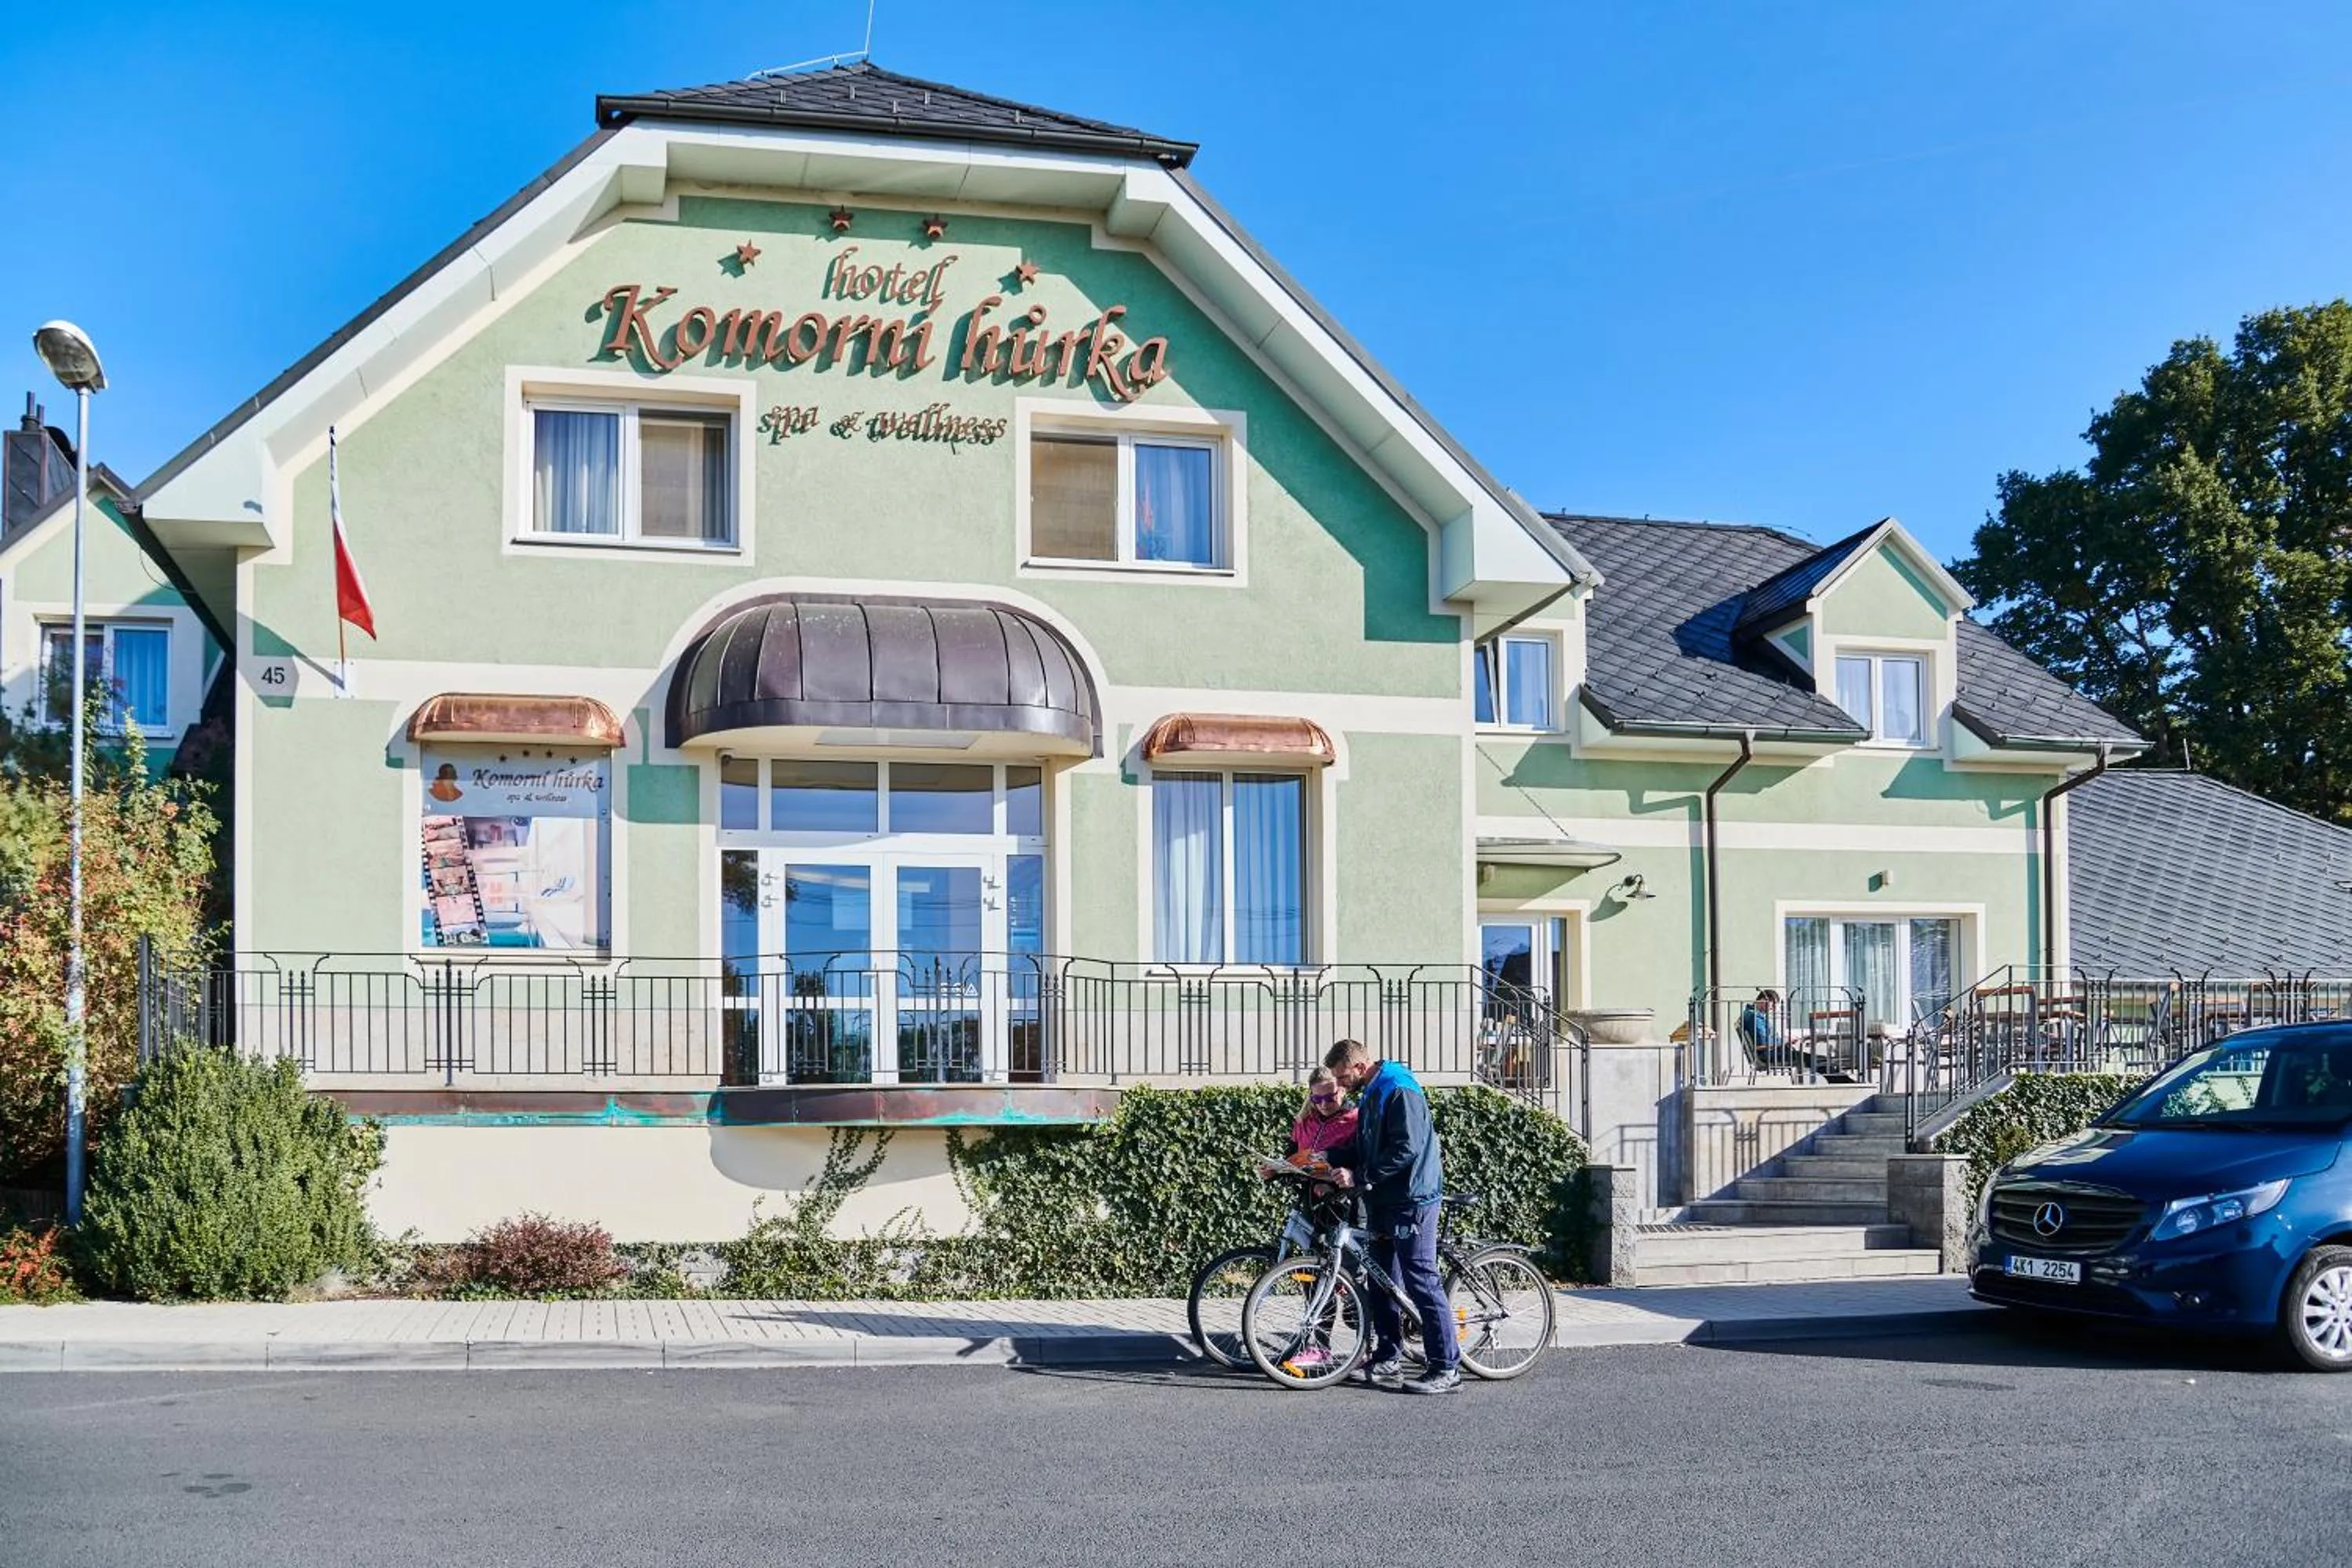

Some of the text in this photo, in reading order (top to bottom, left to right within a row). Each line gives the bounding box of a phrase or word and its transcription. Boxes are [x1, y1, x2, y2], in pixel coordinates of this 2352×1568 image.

[829, 246, 959, 304] hotel
[602, 285, 1171, 402] Komorní hůrka
[764, 402, 1008, 442] spa & wellness
[260, 666, 285, 684] 45
[472, 768, 550, 789] Komorní
[2013, 1258, 2074, 1279] 4K1 2254
